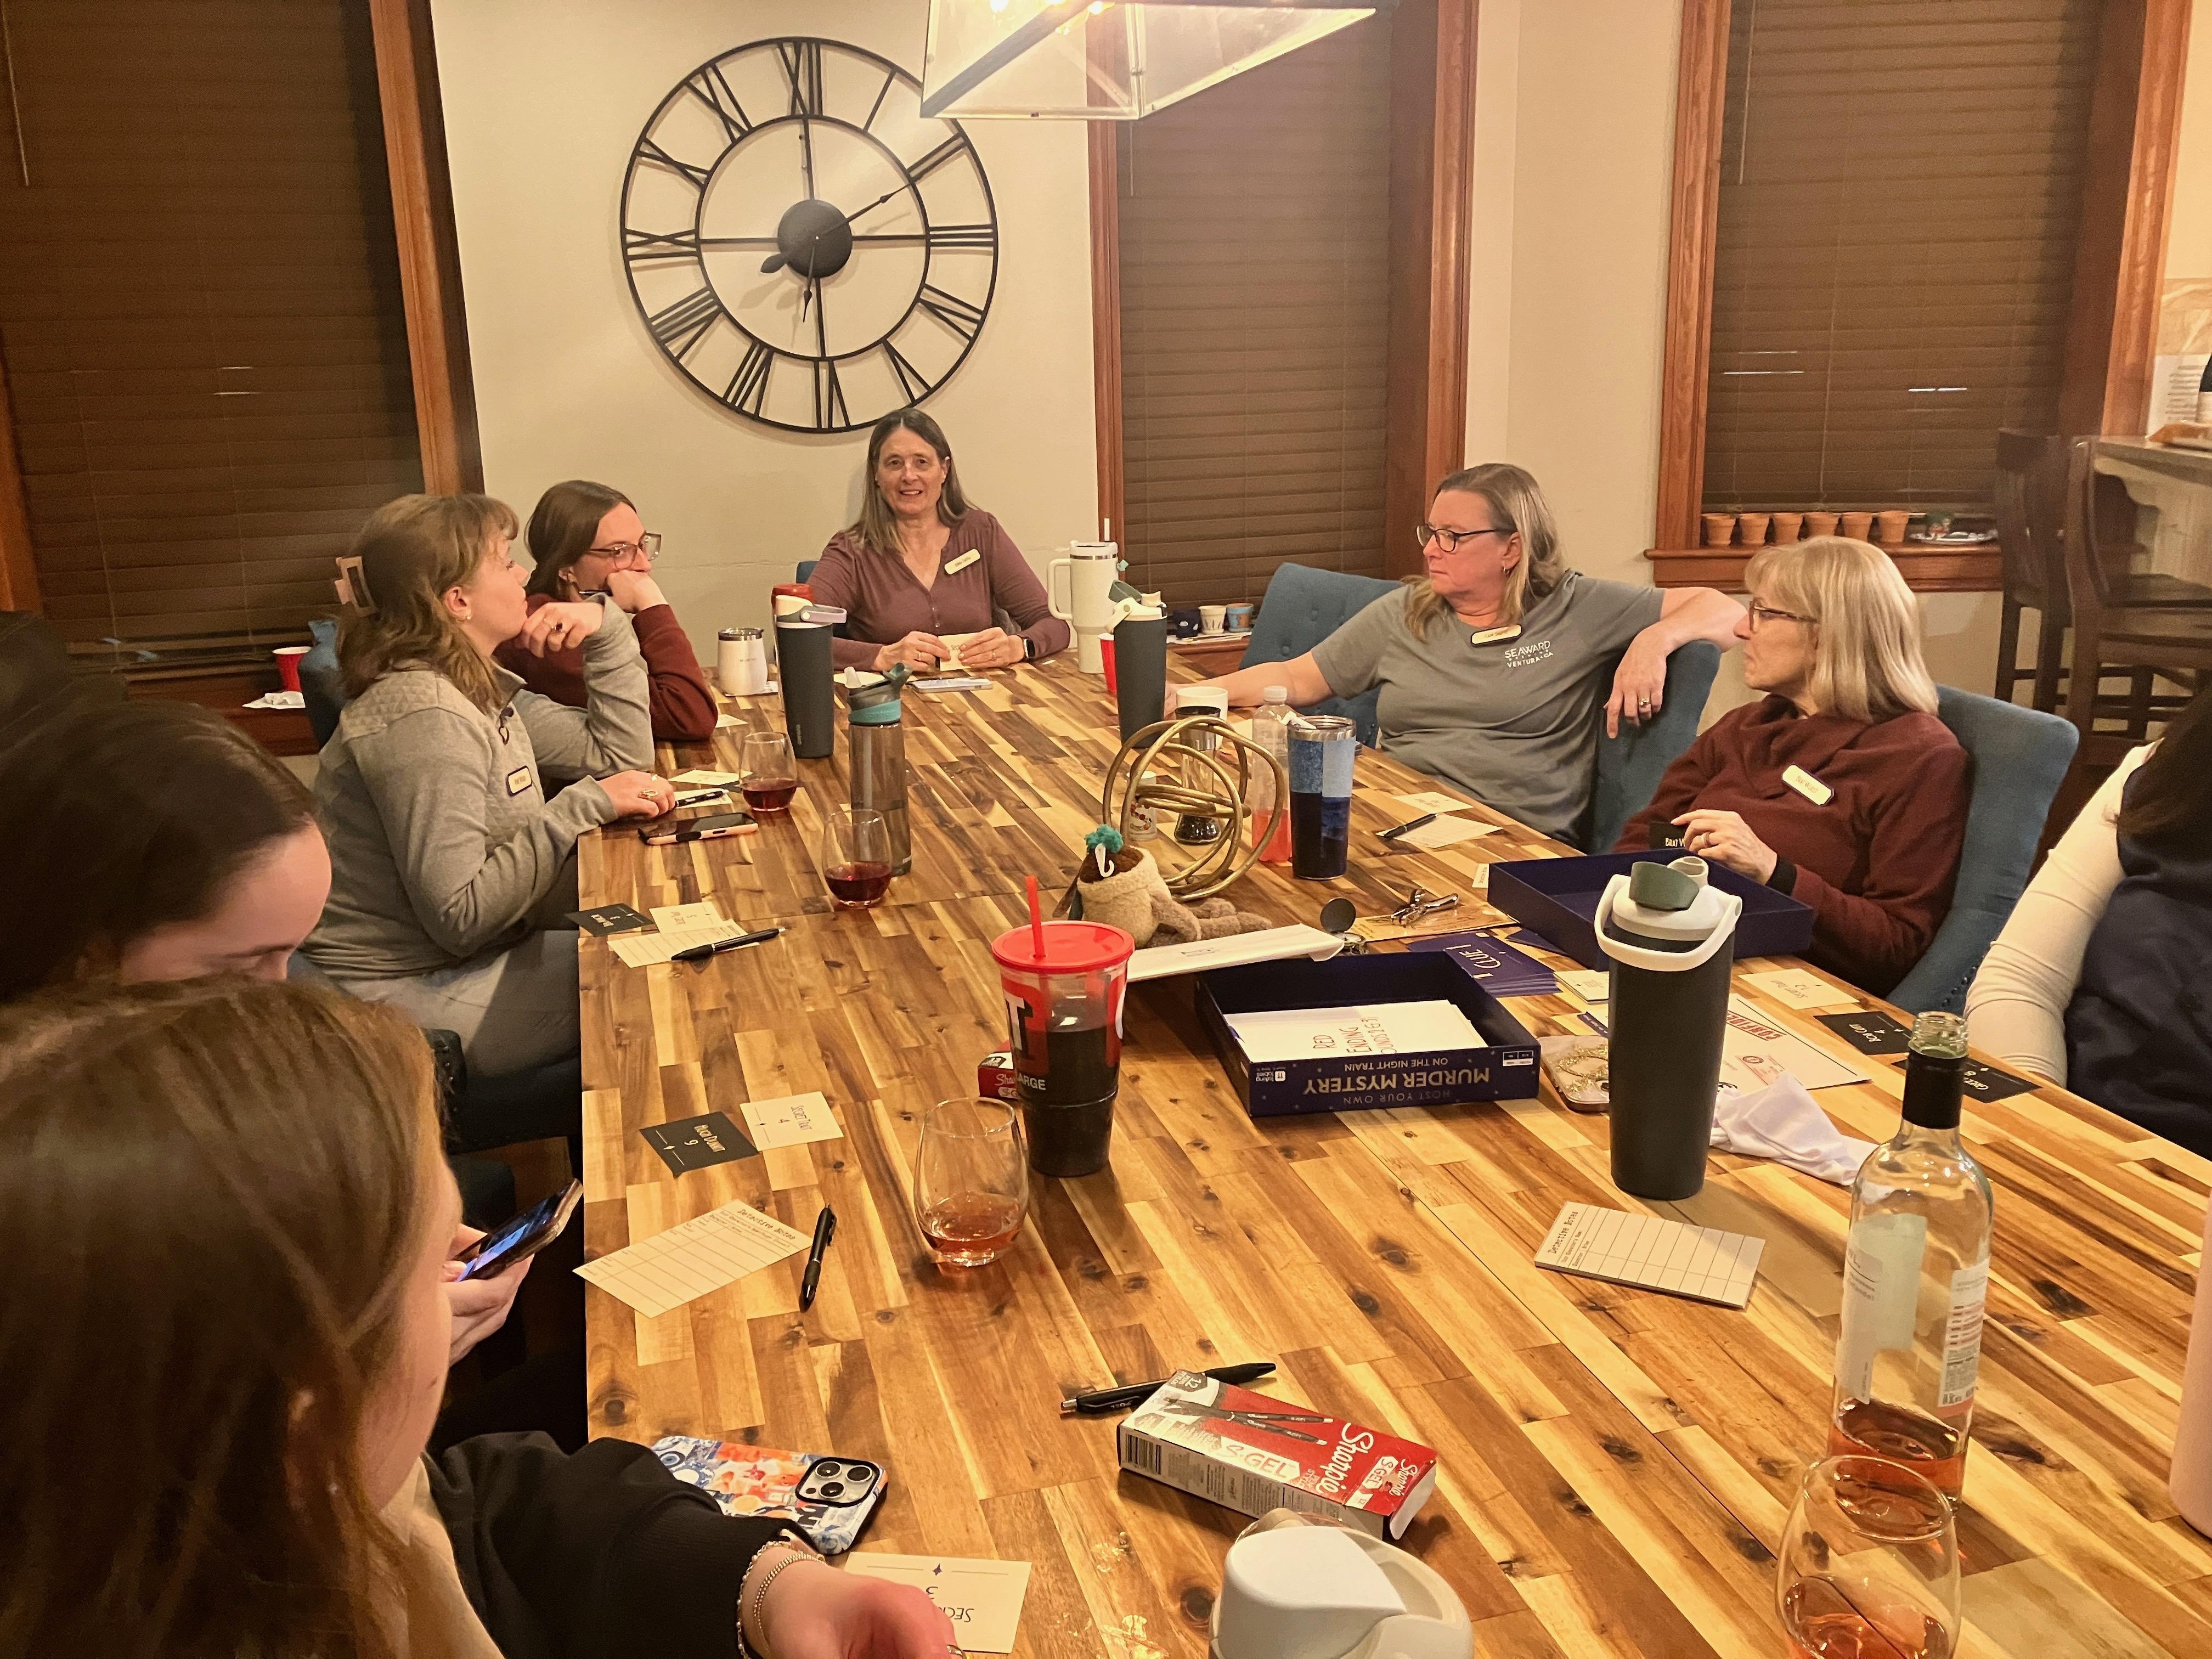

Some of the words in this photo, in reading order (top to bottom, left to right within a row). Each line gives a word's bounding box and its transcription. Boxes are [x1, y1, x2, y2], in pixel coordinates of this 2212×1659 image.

[1505, 640, 1550, 658] SEAWARD
[1459, 949, 1501, 968] CLUE
[1313, 1035, 1338, 1049] RED
[1339, 1027, 1373, 1053] ENDING
[1345, 1062, 1374, 1071] TRAIN
[1376, 1060, 1408, 1070] NIGHT
[1412, 1058, 1430, 1067] THE
[1432, 1058, 1448, 1066] ON
[1018, 1072, 1046, 1091] ARGE
[1302, 1074, 1397, 1095] MYSTERY
[1402, 1067, 1489, 1088] MURDER
[1344, 1095, 1373, 1104] OWN
[1379, 1092, 1413, 1103] YOUR
[1419, 1090, 1450, 1099] HOST
[1316, 1422, 1374, 1494] Sharpie
